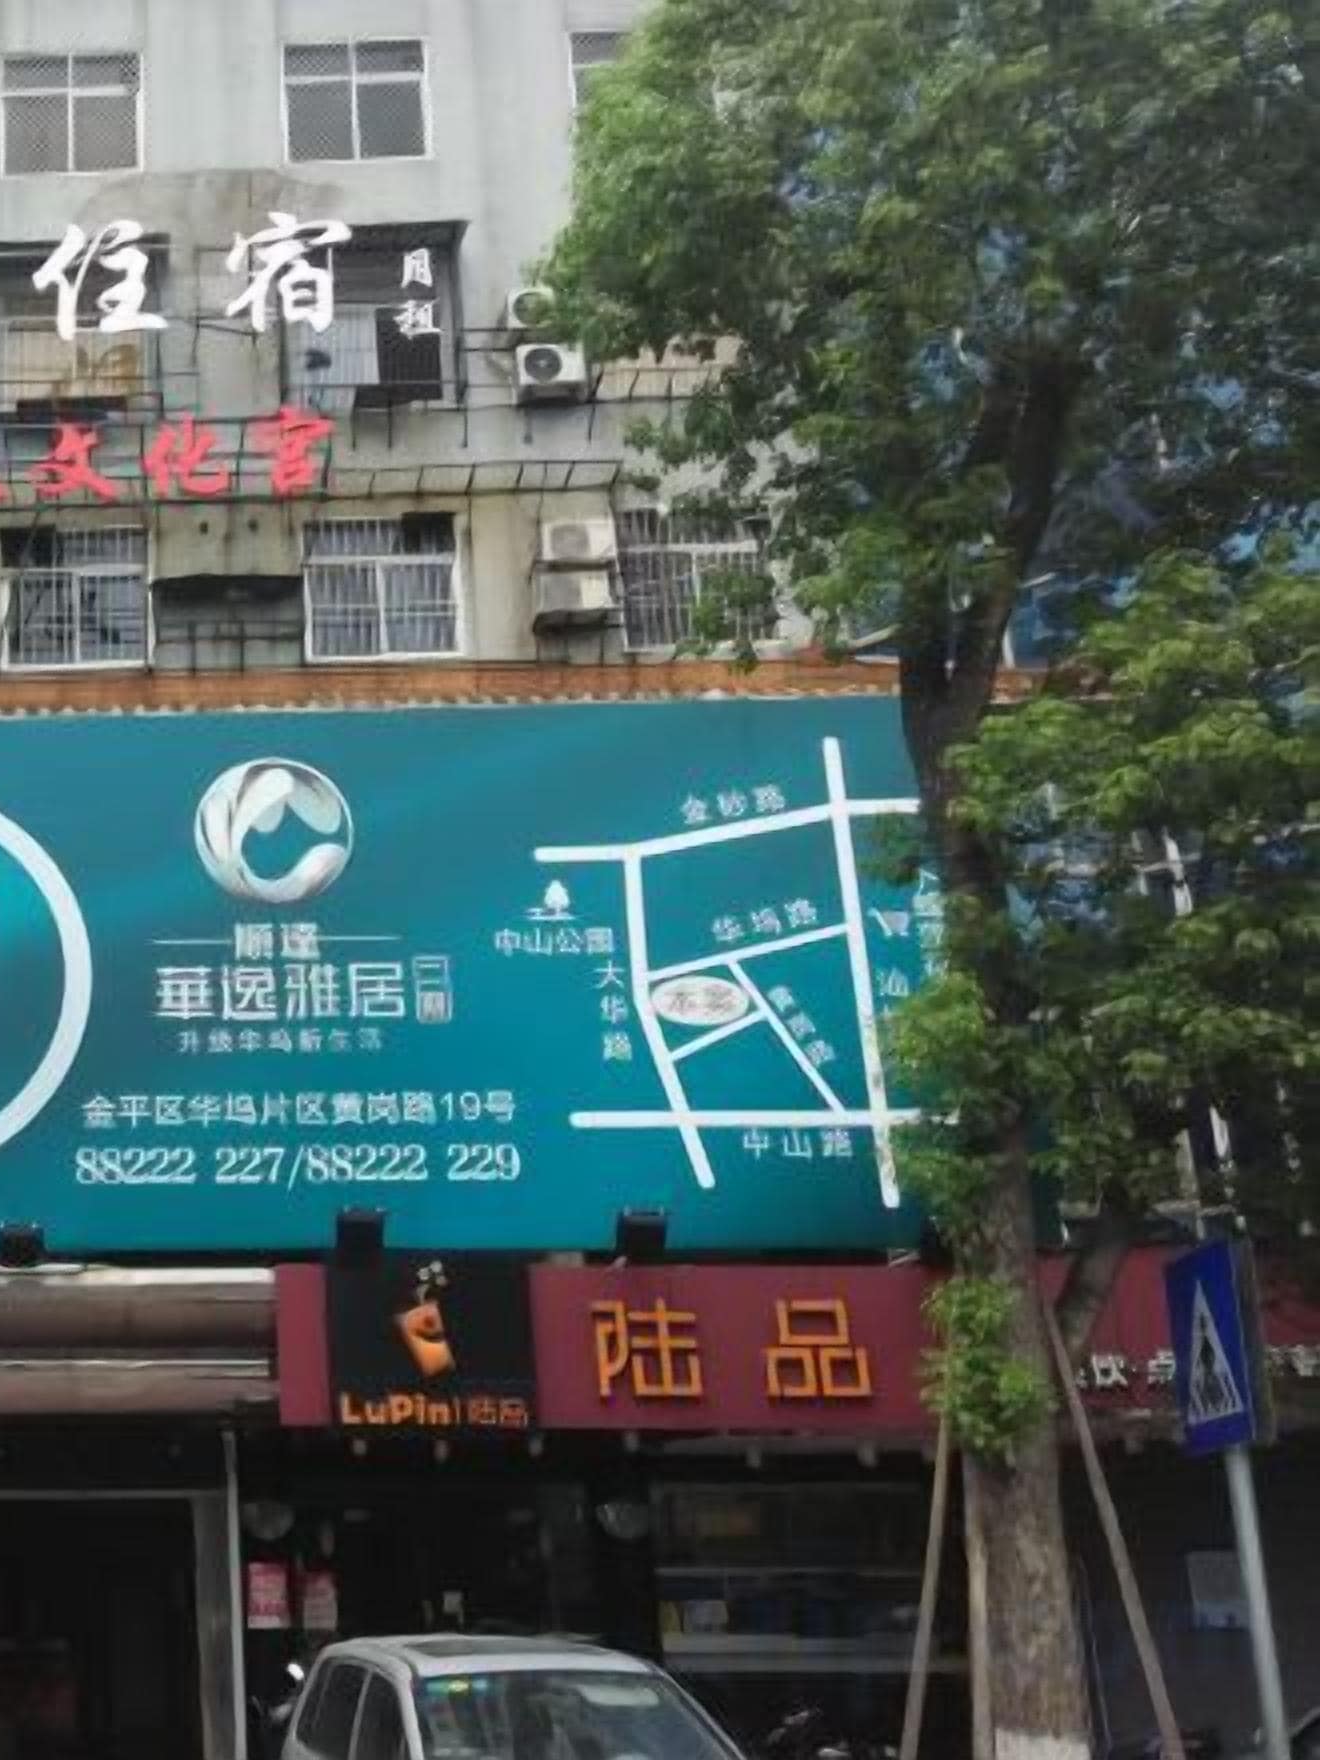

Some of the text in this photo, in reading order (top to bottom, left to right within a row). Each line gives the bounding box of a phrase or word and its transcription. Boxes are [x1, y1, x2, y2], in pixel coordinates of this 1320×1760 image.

[494, 927, 615, 956] 中山公园
[742, 1128, 854, 1160] 中山路
[76, 1146, 196, 1184] 88222
[446, 1143, 520, 1182] 229
[590, 1298, 872, 1397] 陆品
